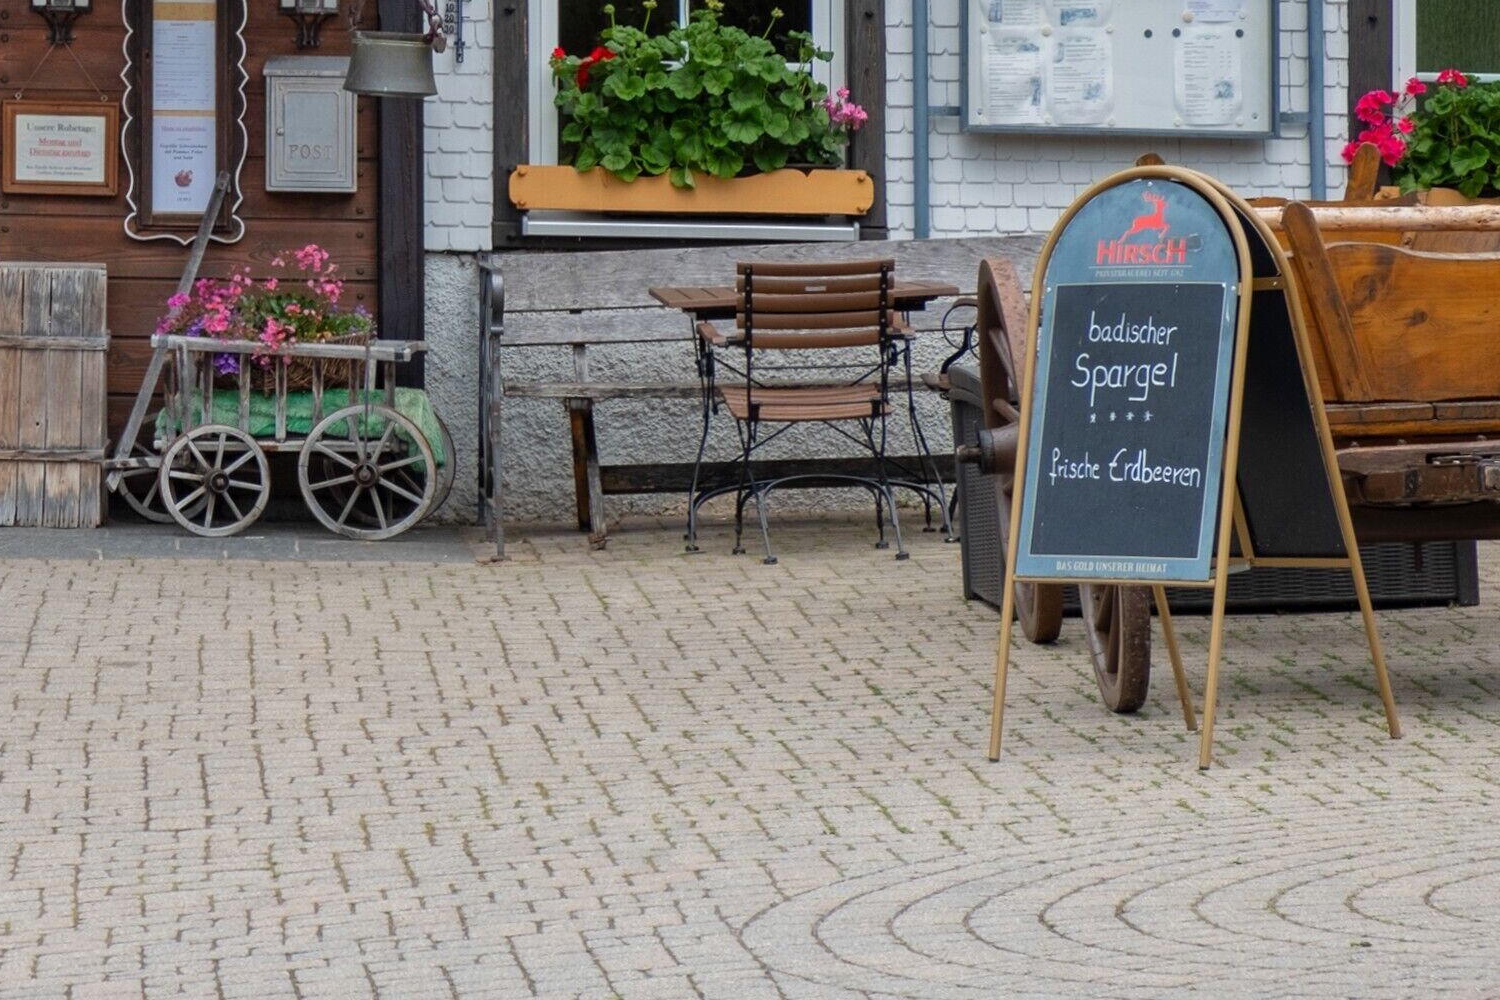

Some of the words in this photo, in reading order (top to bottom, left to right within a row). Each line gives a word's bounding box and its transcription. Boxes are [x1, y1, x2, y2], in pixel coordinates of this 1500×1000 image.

[288, 144, 333, 160] POST
[1097, 239, 1187, 264] HIRSCH
[1089, 310, 1177, 346] badischer
[1071, 352, 1178, 407] Spargel
[1049, 447, 1100, 486] frische
[1108, 448, 1200, 488] Erdbeeren
[1056, 560, 1072, 571] DAS
[1073, 560, 1094, 571] GOLD
[1095, 561, 1133, 573] UNSERER
[1135, 562, 1168, 573] HEIMAT
